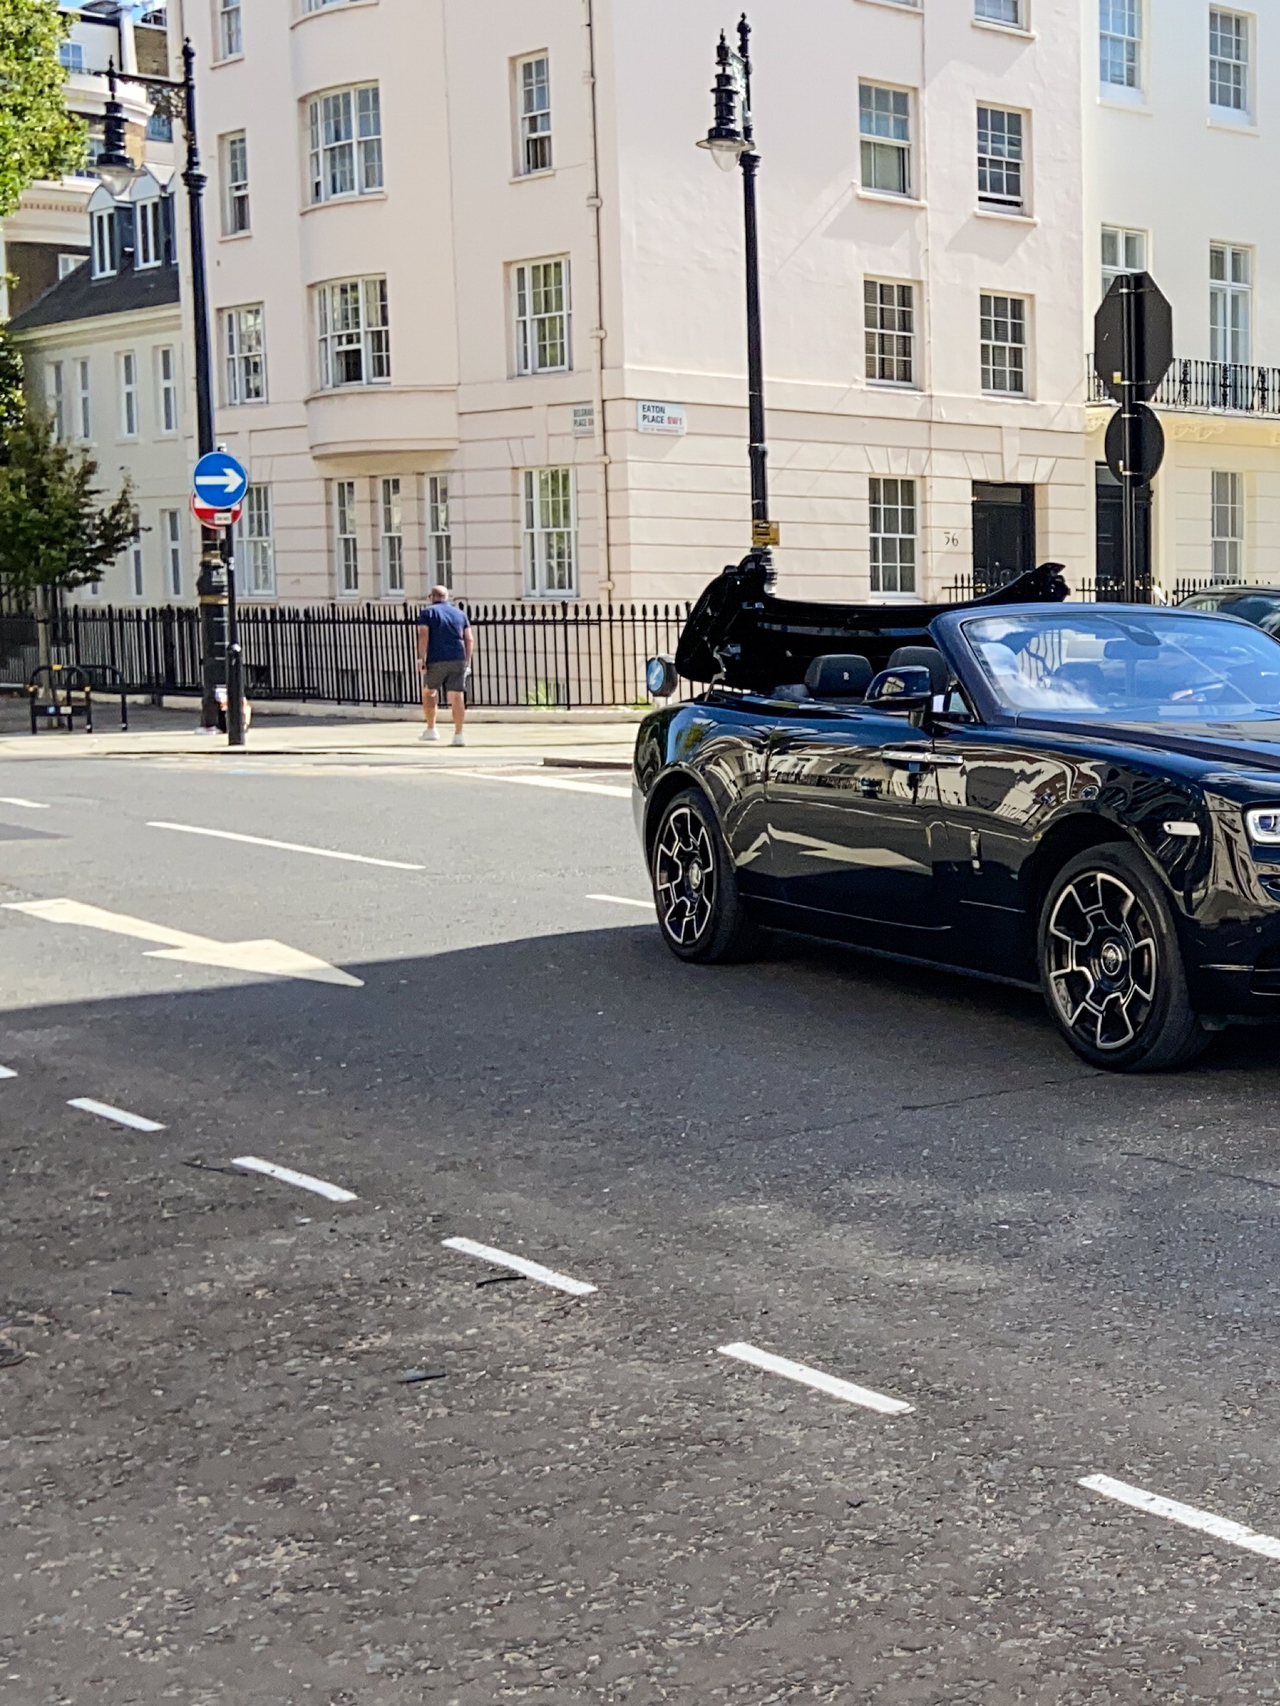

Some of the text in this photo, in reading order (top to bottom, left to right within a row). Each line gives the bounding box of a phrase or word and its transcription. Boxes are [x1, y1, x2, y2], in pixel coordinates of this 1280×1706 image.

[642, 404, 666, 414] EATON
[642, 414, 682, 425] PLACE SW1
